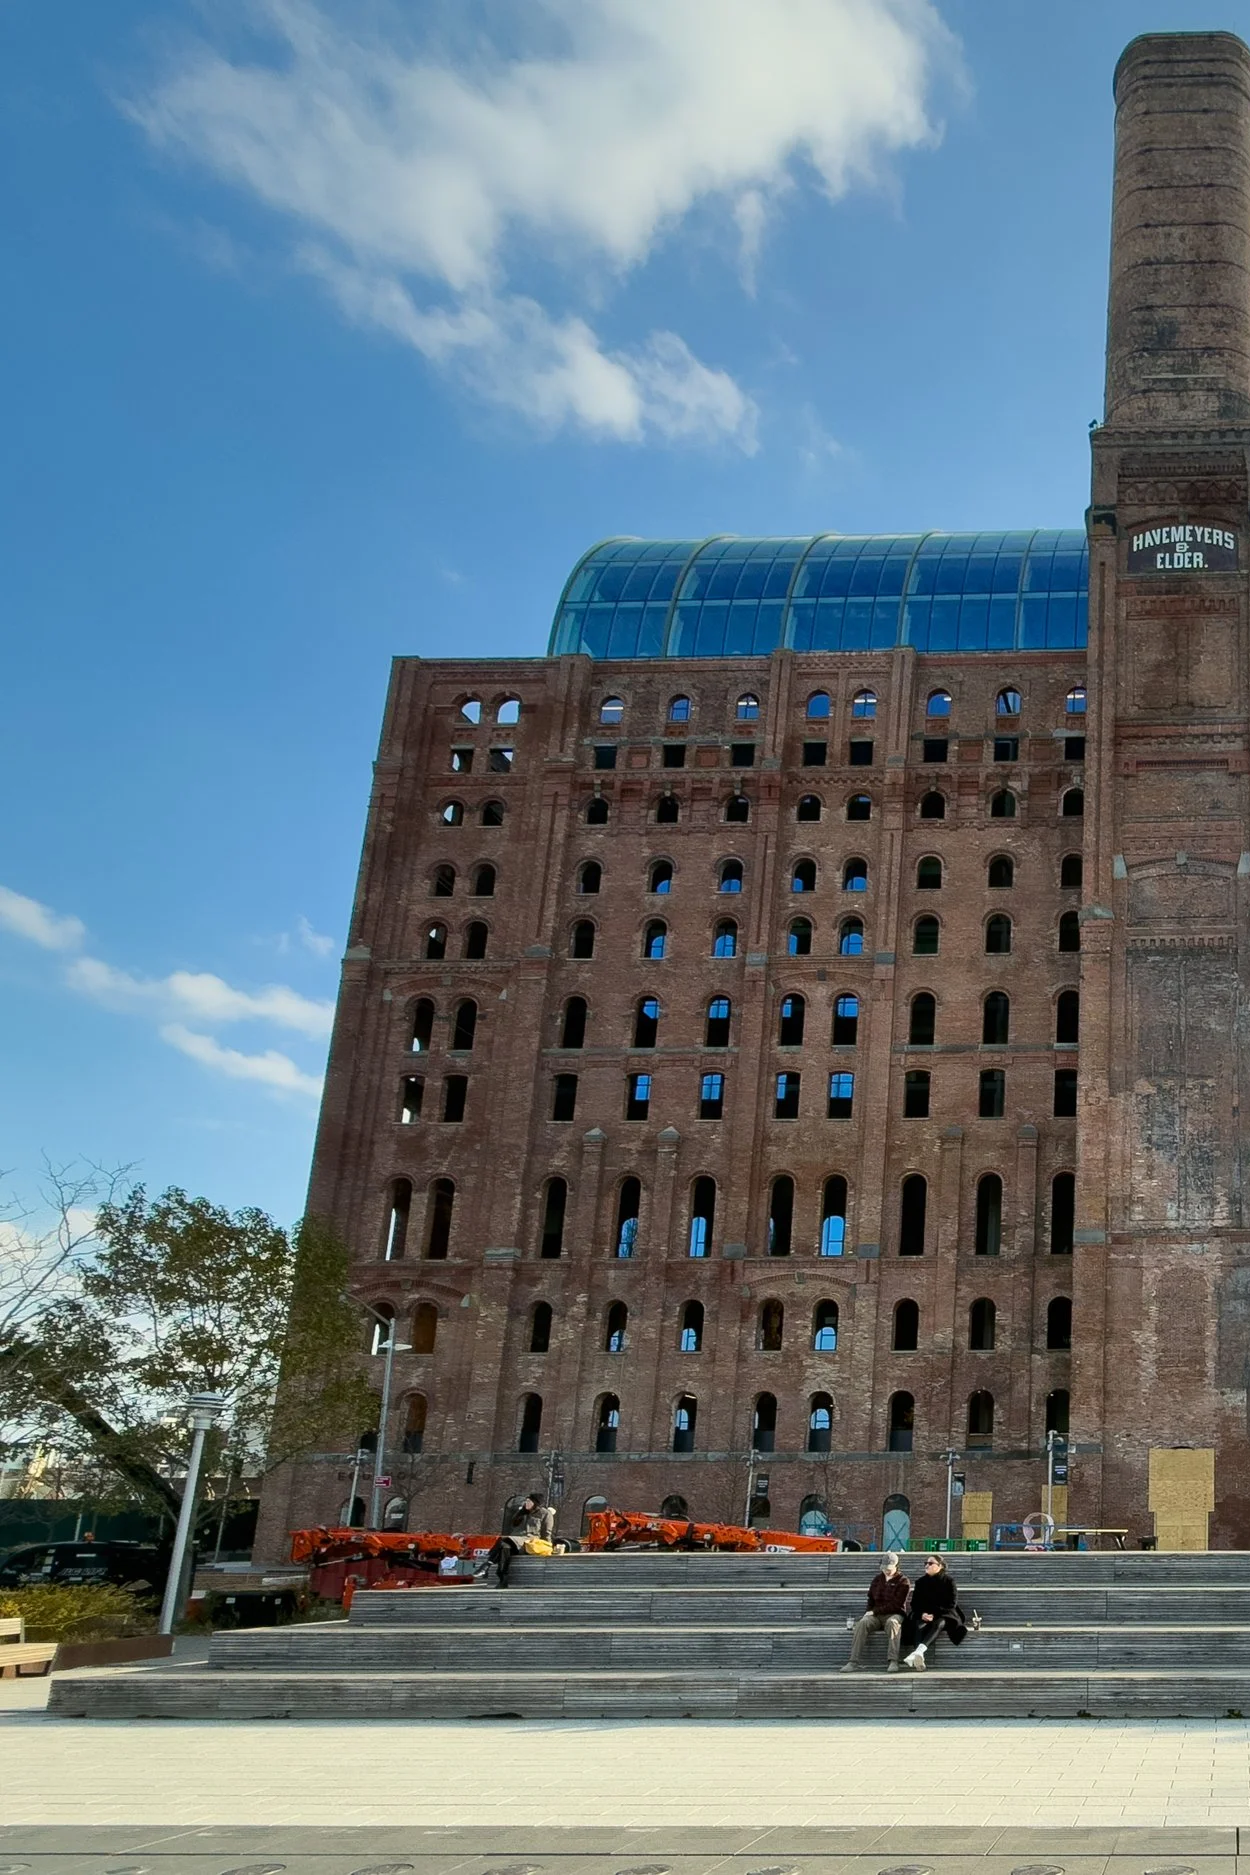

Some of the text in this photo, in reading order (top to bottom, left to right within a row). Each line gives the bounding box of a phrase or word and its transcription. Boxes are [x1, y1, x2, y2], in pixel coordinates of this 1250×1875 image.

[1132, 525, 1235, 552] HAVEMEYERS
[1175, 542, 1189, 553] &
[1156, 552, 1209, 569] ELDER.
